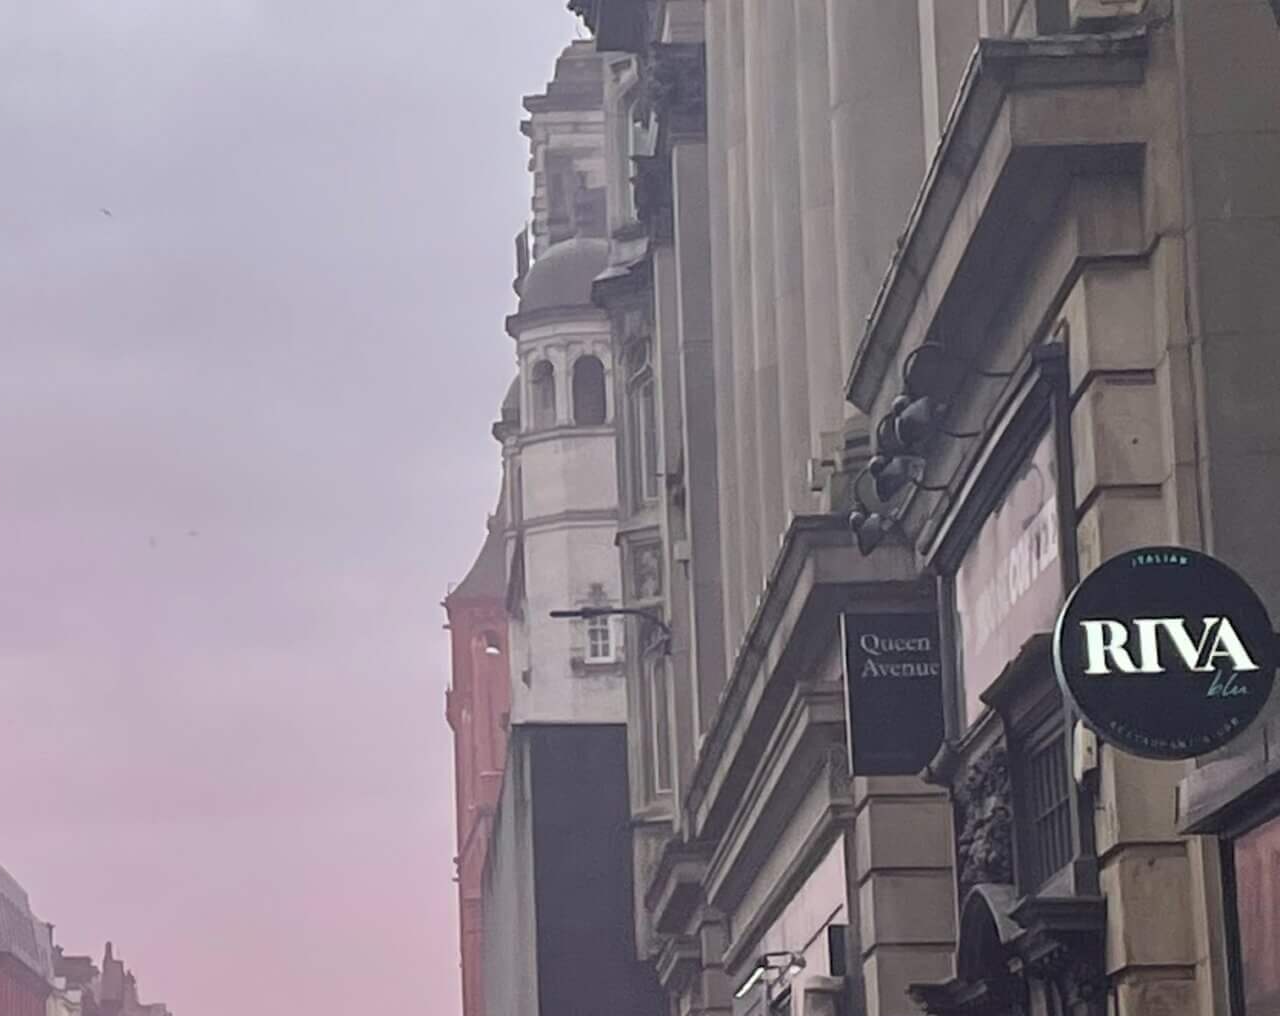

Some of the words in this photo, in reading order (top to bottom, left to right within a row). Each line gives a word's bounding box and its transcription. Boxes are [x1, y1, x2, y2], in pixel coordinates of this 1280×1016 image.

[860, 633, 931, 656] Queen
[1080, 616, 1260, 675] RIVA
[861, 658, 940, 677] Avenue
